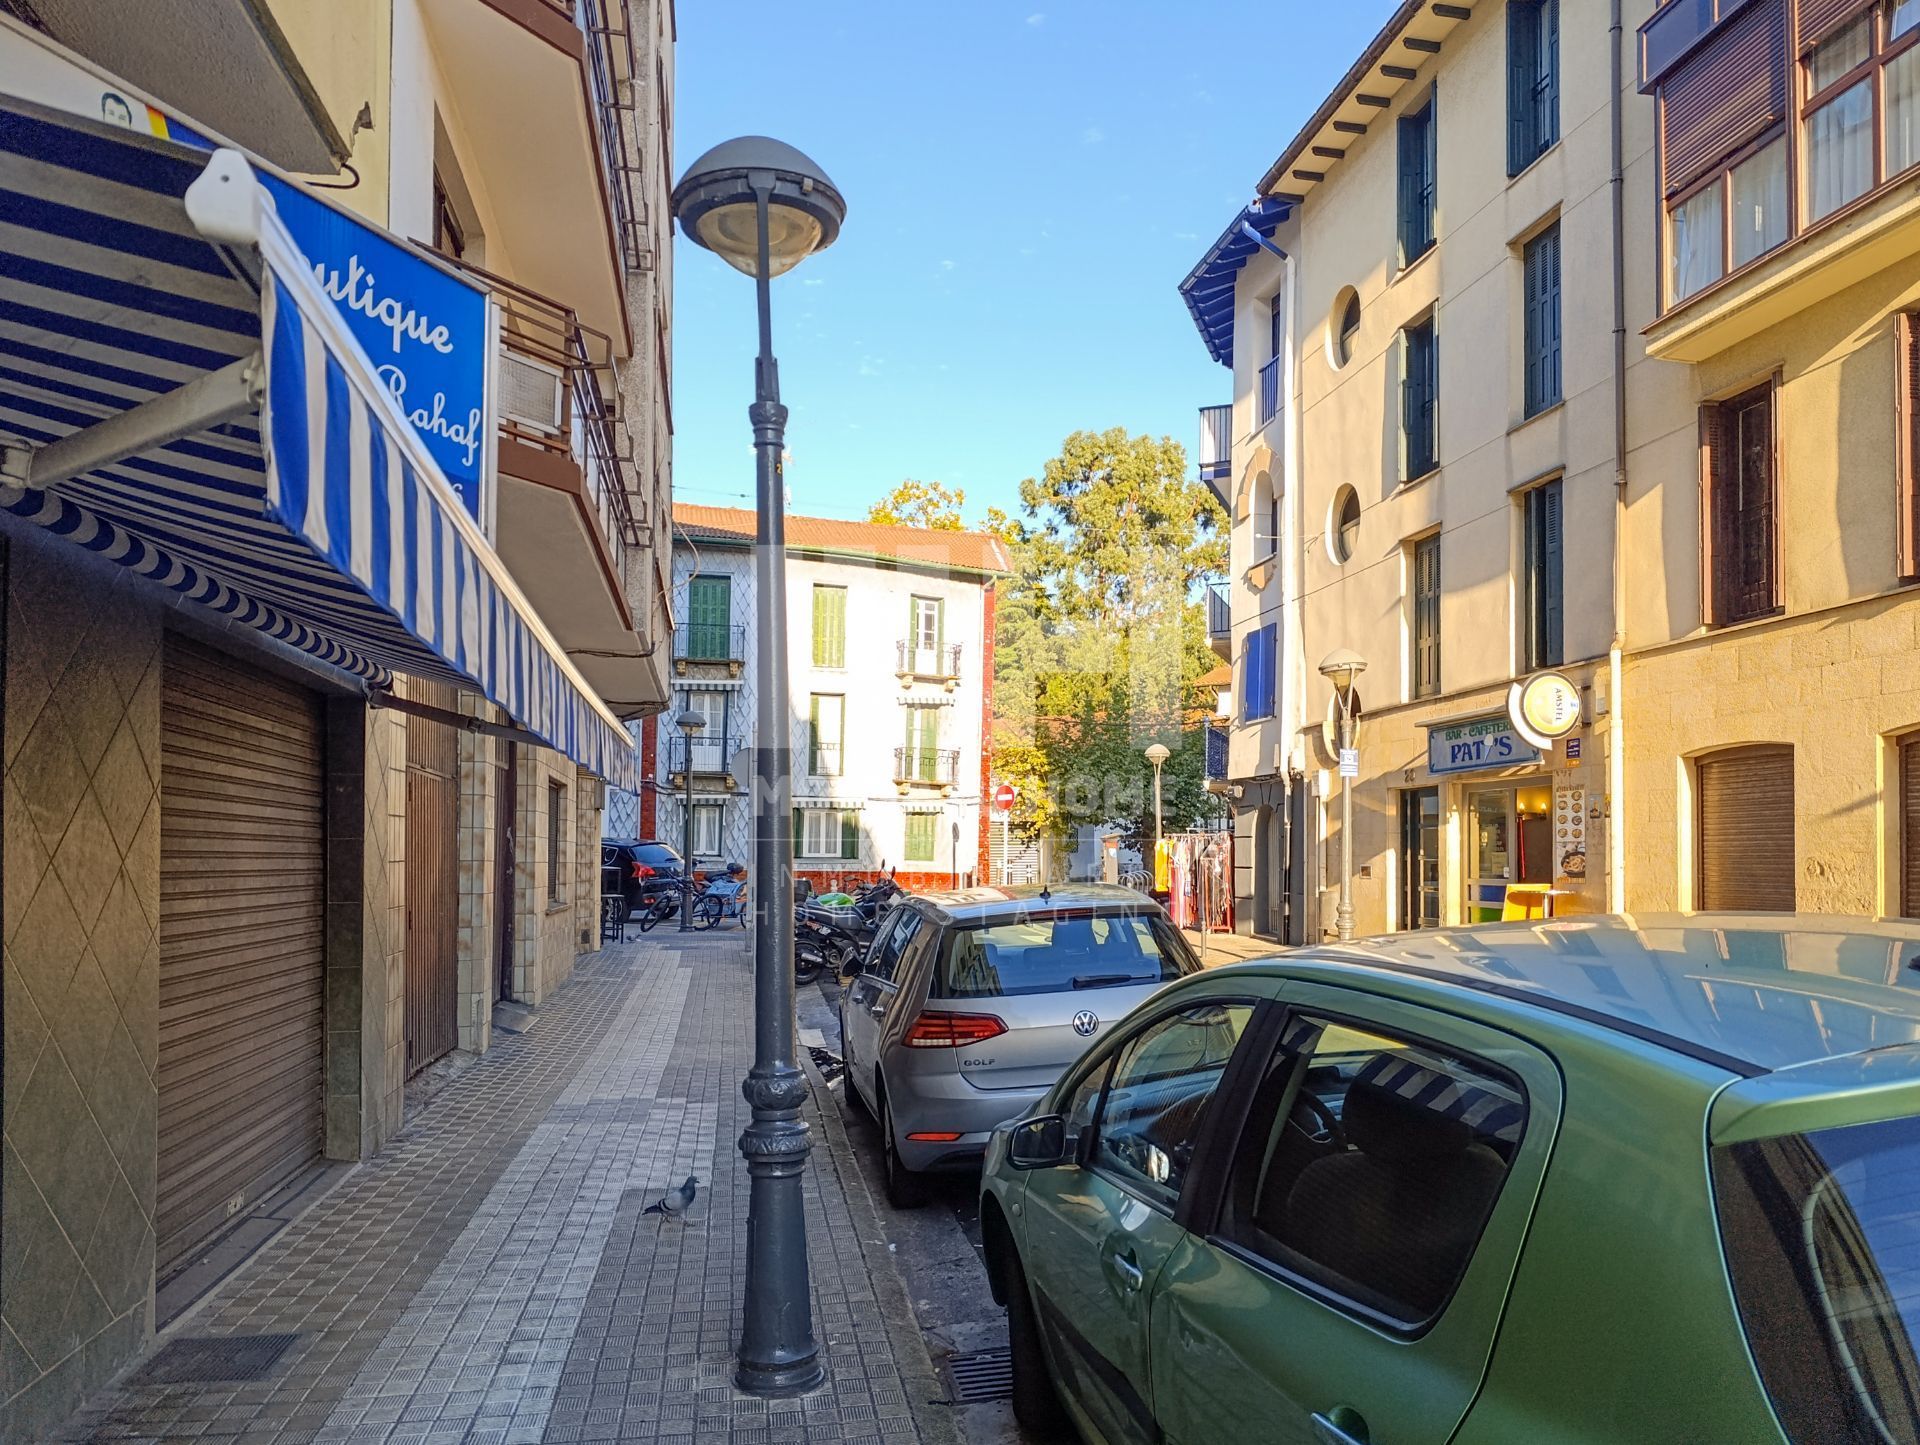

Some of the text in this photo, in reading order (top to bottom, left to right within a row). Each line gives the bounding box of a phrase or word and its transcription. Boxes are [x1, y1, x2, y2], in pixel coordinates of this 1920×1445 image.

[1554, 687, 1563, 720] AMSTEL
[1445, 730, 1462, 741] BAR
[1468, 721, 1512, 737] CAFETER
[1451, 735, 1513, 763] PAT'S
[963, 1058, 996, 1067] GOLF
